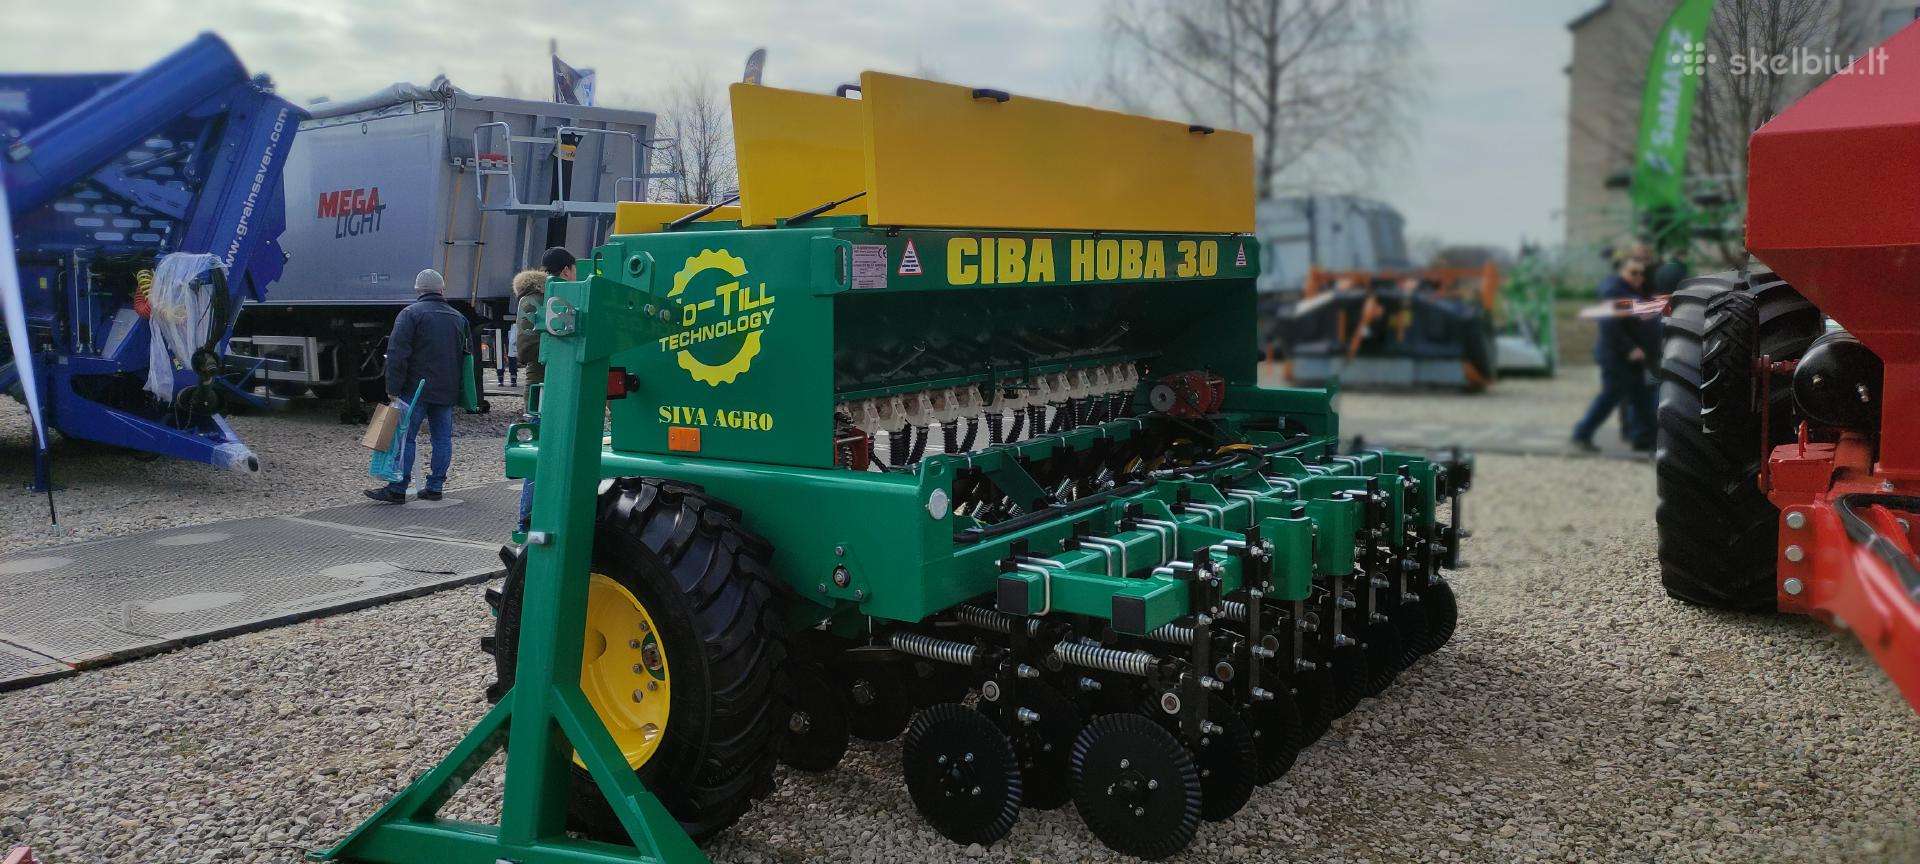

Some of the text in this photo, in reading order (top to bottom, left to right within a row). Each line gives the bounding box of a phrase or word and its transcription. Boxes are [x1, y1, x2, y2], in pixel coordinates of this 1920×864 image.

[317, 187, 380, 219] MEGA
[335, 203, 386, 239] LIGHT
[947, 238, 1056, 285] CIBA
[1070, 240, 1166, 282] HOBA
[675, 281, 776, 327] O-TILL
[658, 308, 775, 352] TECHNOLOGY
[658, 405, 773, 431] SIVA AGRO
